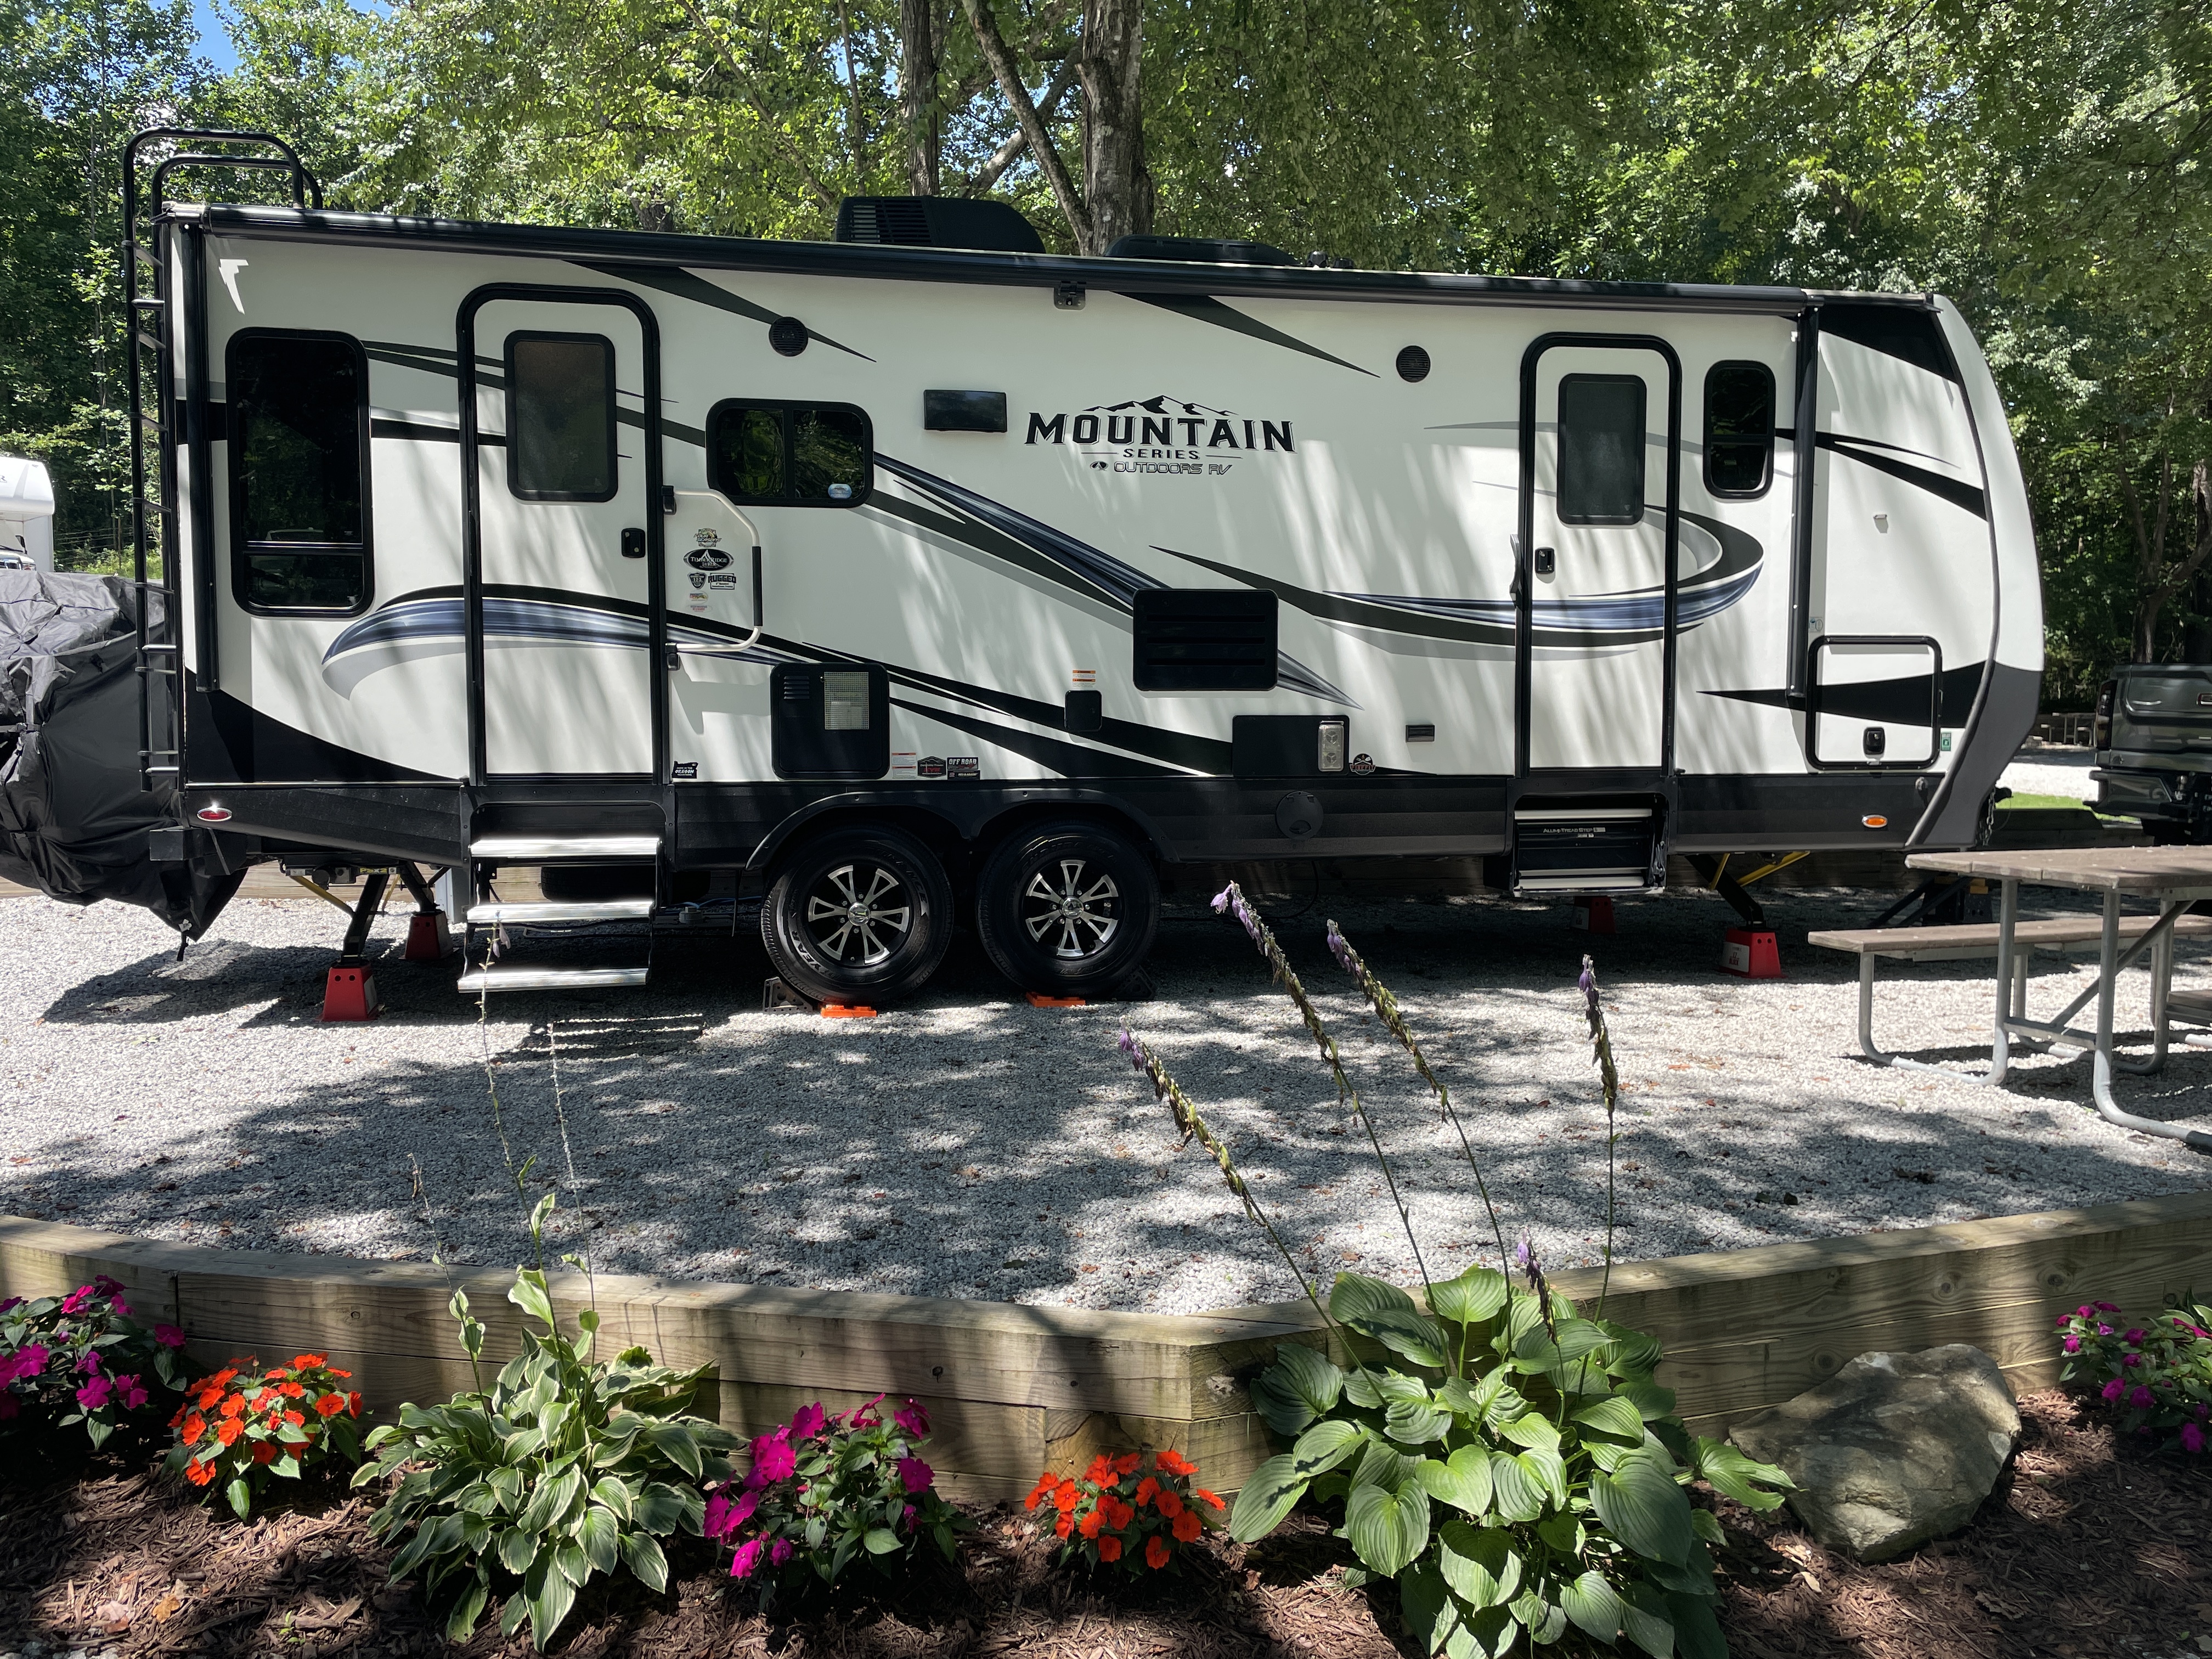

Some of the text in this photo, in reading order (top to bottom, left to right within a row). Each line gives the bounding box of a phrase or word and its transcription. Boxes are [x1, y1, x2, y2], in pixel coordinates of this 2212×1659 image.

[1024, 412, 1297, 453] MOUNTAIN
[1122, 448, 1201, 460] SERIES
[1114, 460, 1233, 475] OUTDOORS RV
[708, 575, 736, 583] RUGGED
